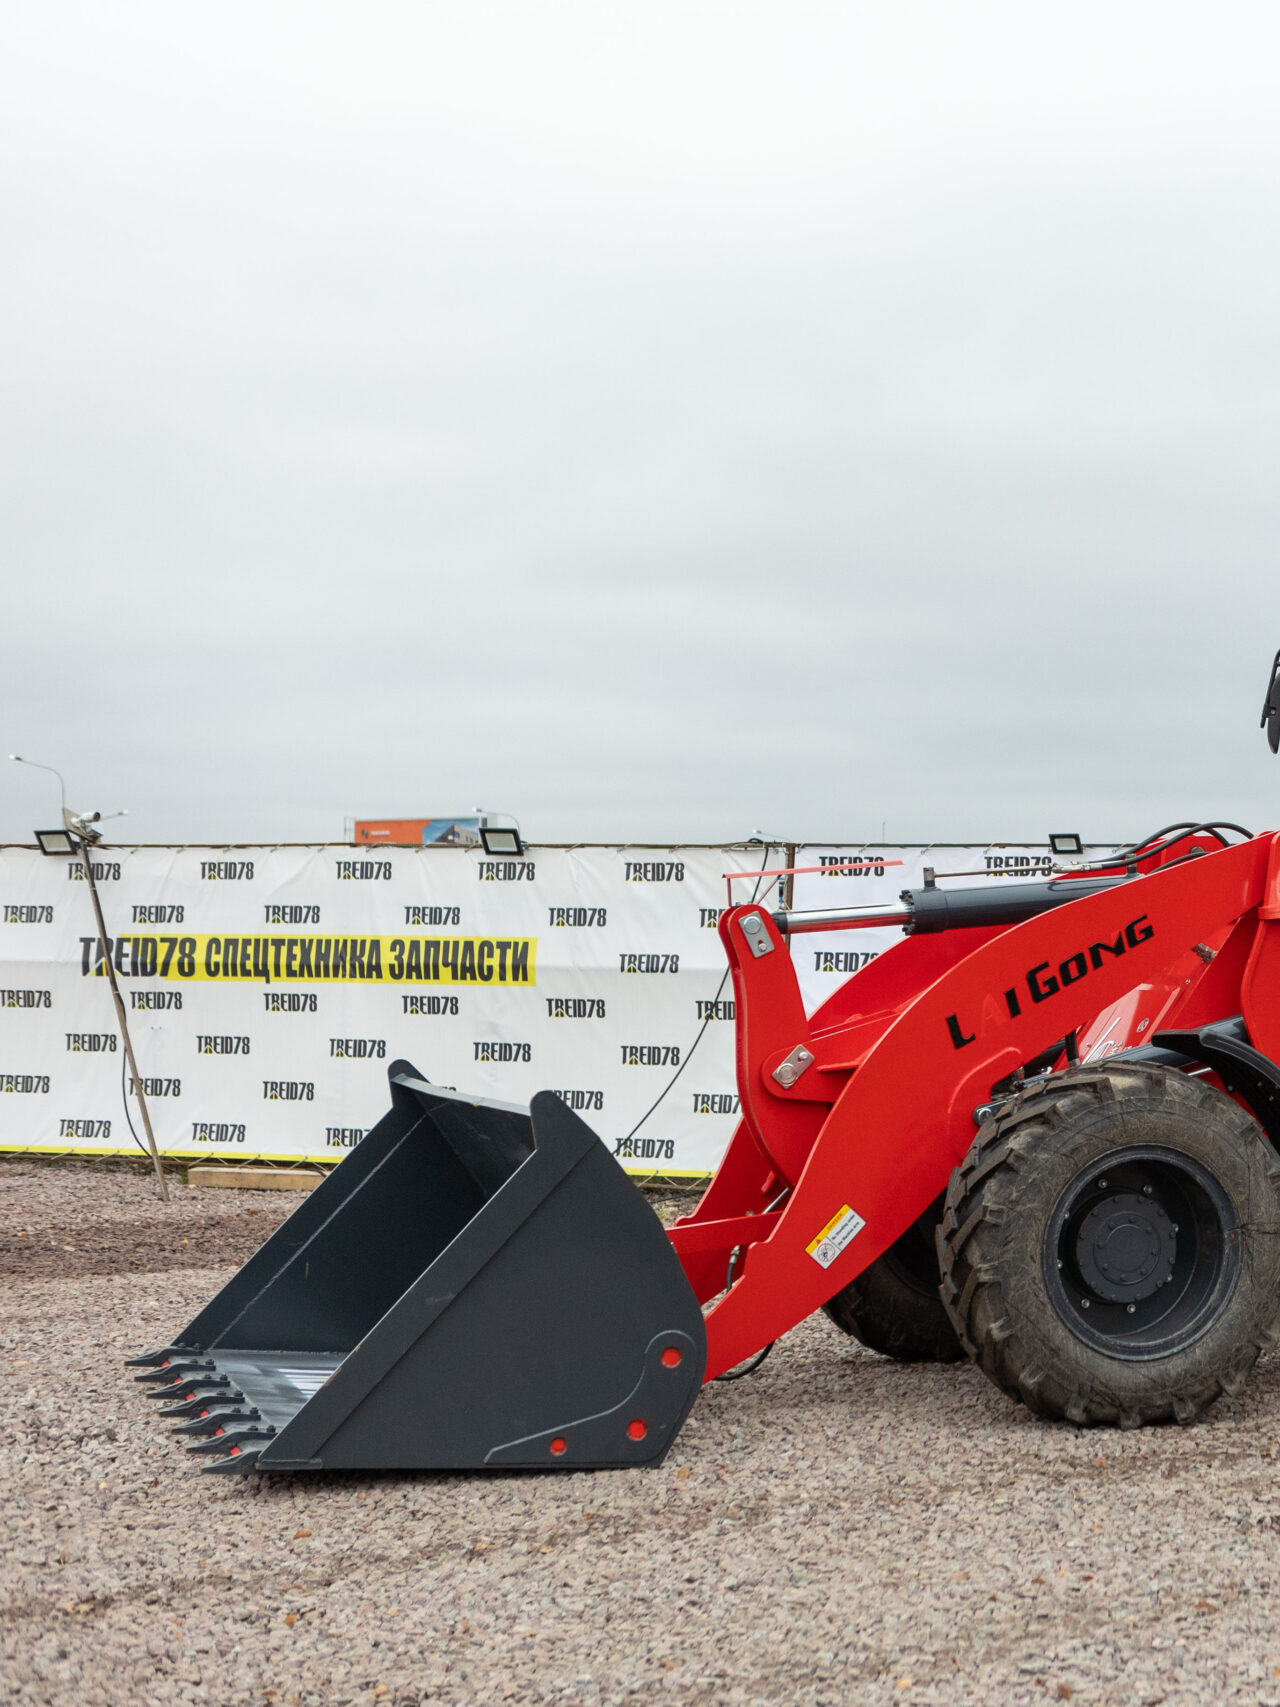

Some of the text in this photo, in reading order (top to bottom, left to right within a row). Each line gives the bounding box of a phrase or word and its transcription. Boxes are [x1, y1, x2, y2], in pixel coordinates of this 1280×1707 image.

[201, 862, 254, 880] TREID78
[336, 862, 391, 880] TREID78
[478, 862, 535, 881] TREID78
[625, 863, 684, 881] TREID78
[4, 906, 53, 923] TREID78
[132, 906, 184, 923] TREID78
[265, 906, 320, 923] TREID78
[405, 907, 460, 925] TREID78
[549, 908, 606, 926] TREID78
[205, 938, 383, 983] СПЕЦТЕХНИКА
[389, 940, 529, 981] ЗАПЧАСТИ
[620, 954, 679, 973] TREID78
[0, 990, 51, 1008] TREID78
[130, 992, 182, 1009] TREID78
[264, 993, 317, 1012] TREID78
[402, 996, 458, 1015] TREID78
[546, 999, 605, 1018] TREID78
[66, 1034, 117, 1052] TREID78
[197, 1036, 249, 1054] TREID78
[330, 1039, 386, 1058] TREID78
[473, 1043, 531, 1062] TREID78
[621, 1046, 680, 1066] TREID78
[0, 1075, 50, 1093] TREID78
[263, 1081, 314, 1100] TREID78
[60, 1120, 111, 1138] TREID78
[193, 1123, 245, 1142] TREID78
[615, 1138, 675, 1158] TREID78
